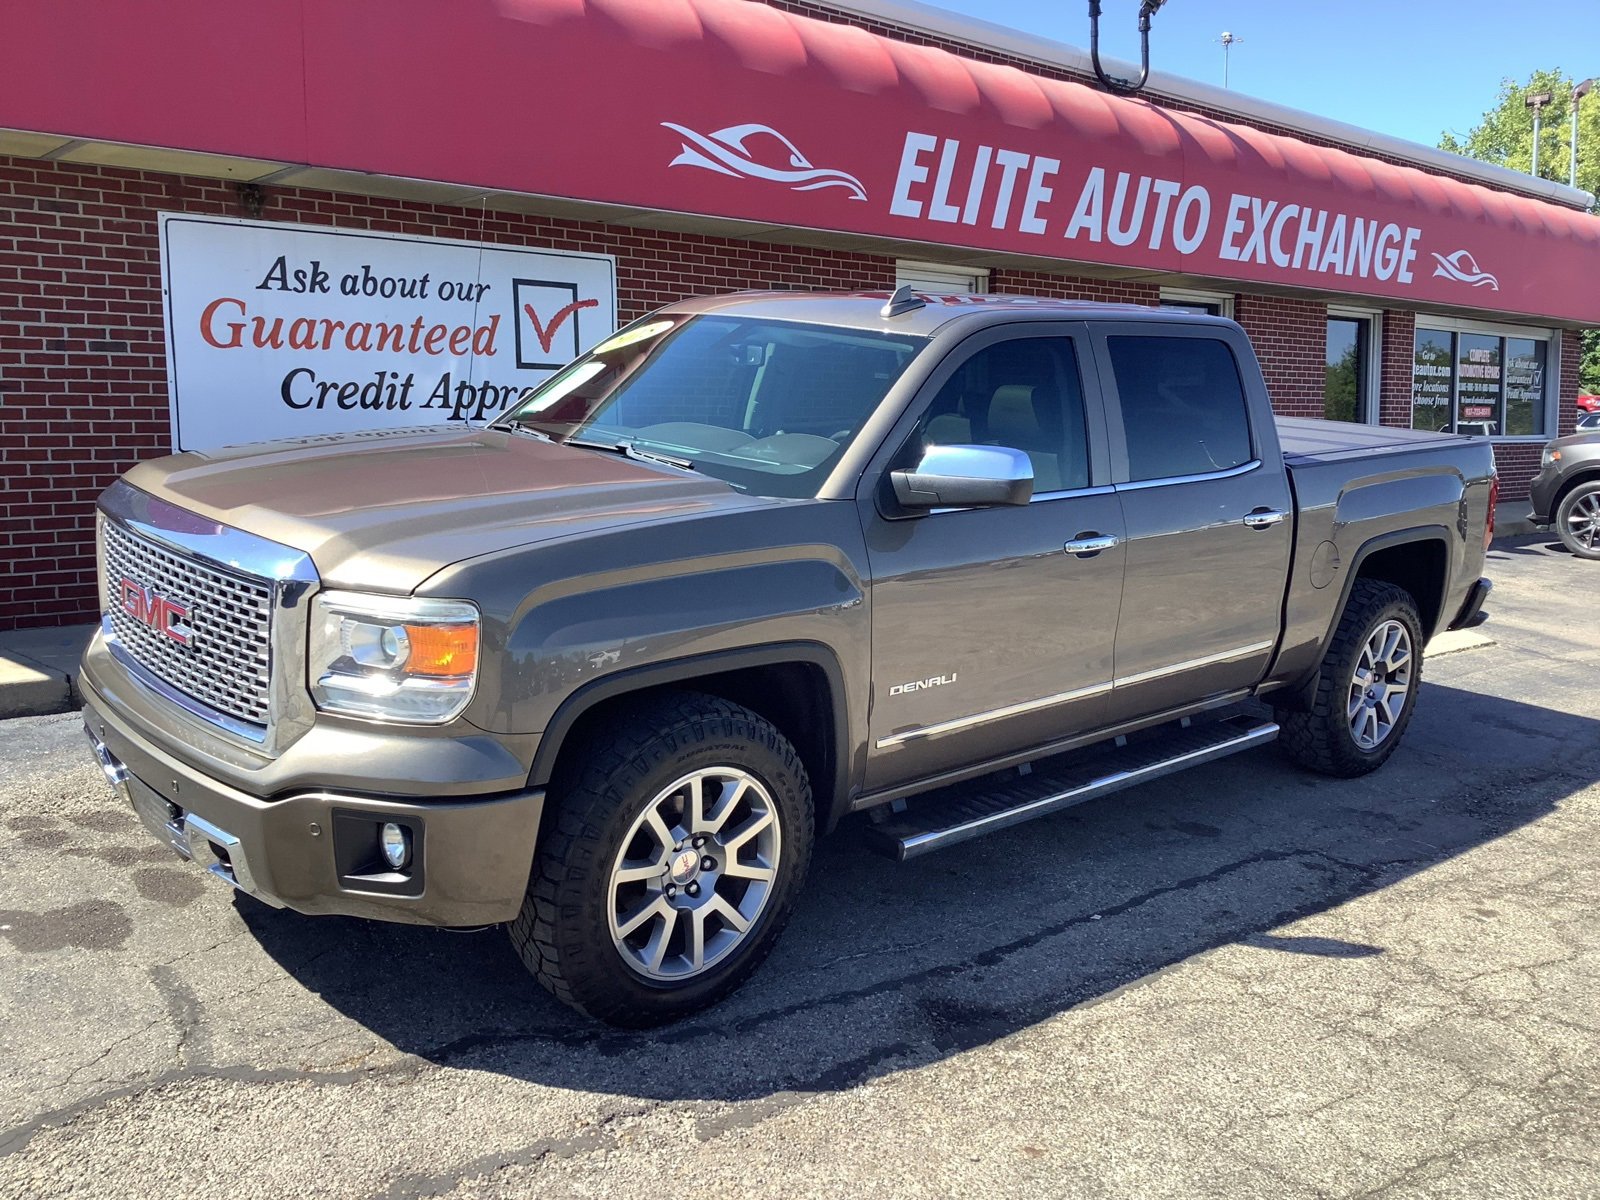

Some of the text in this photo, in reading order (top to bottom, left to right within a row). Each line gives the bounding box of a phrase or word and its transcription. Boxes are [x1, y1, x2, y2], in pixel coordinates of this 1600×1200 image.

[889, 131, 1421, 283] ELITE AUTO EXCHANGE
[256, 255, 491, 303] Ask about our
[200, 297, 499, 356] Guaranteed
[281, 368, 413, 410] Credit
[1414, 393, 1434, 405] choose
[1433, 394, 1449, 408] from
[1423, 380, 1449, 393] locations
[121, 577, 194, 646] GMC
[889, 672, 957, 696] DENALI
